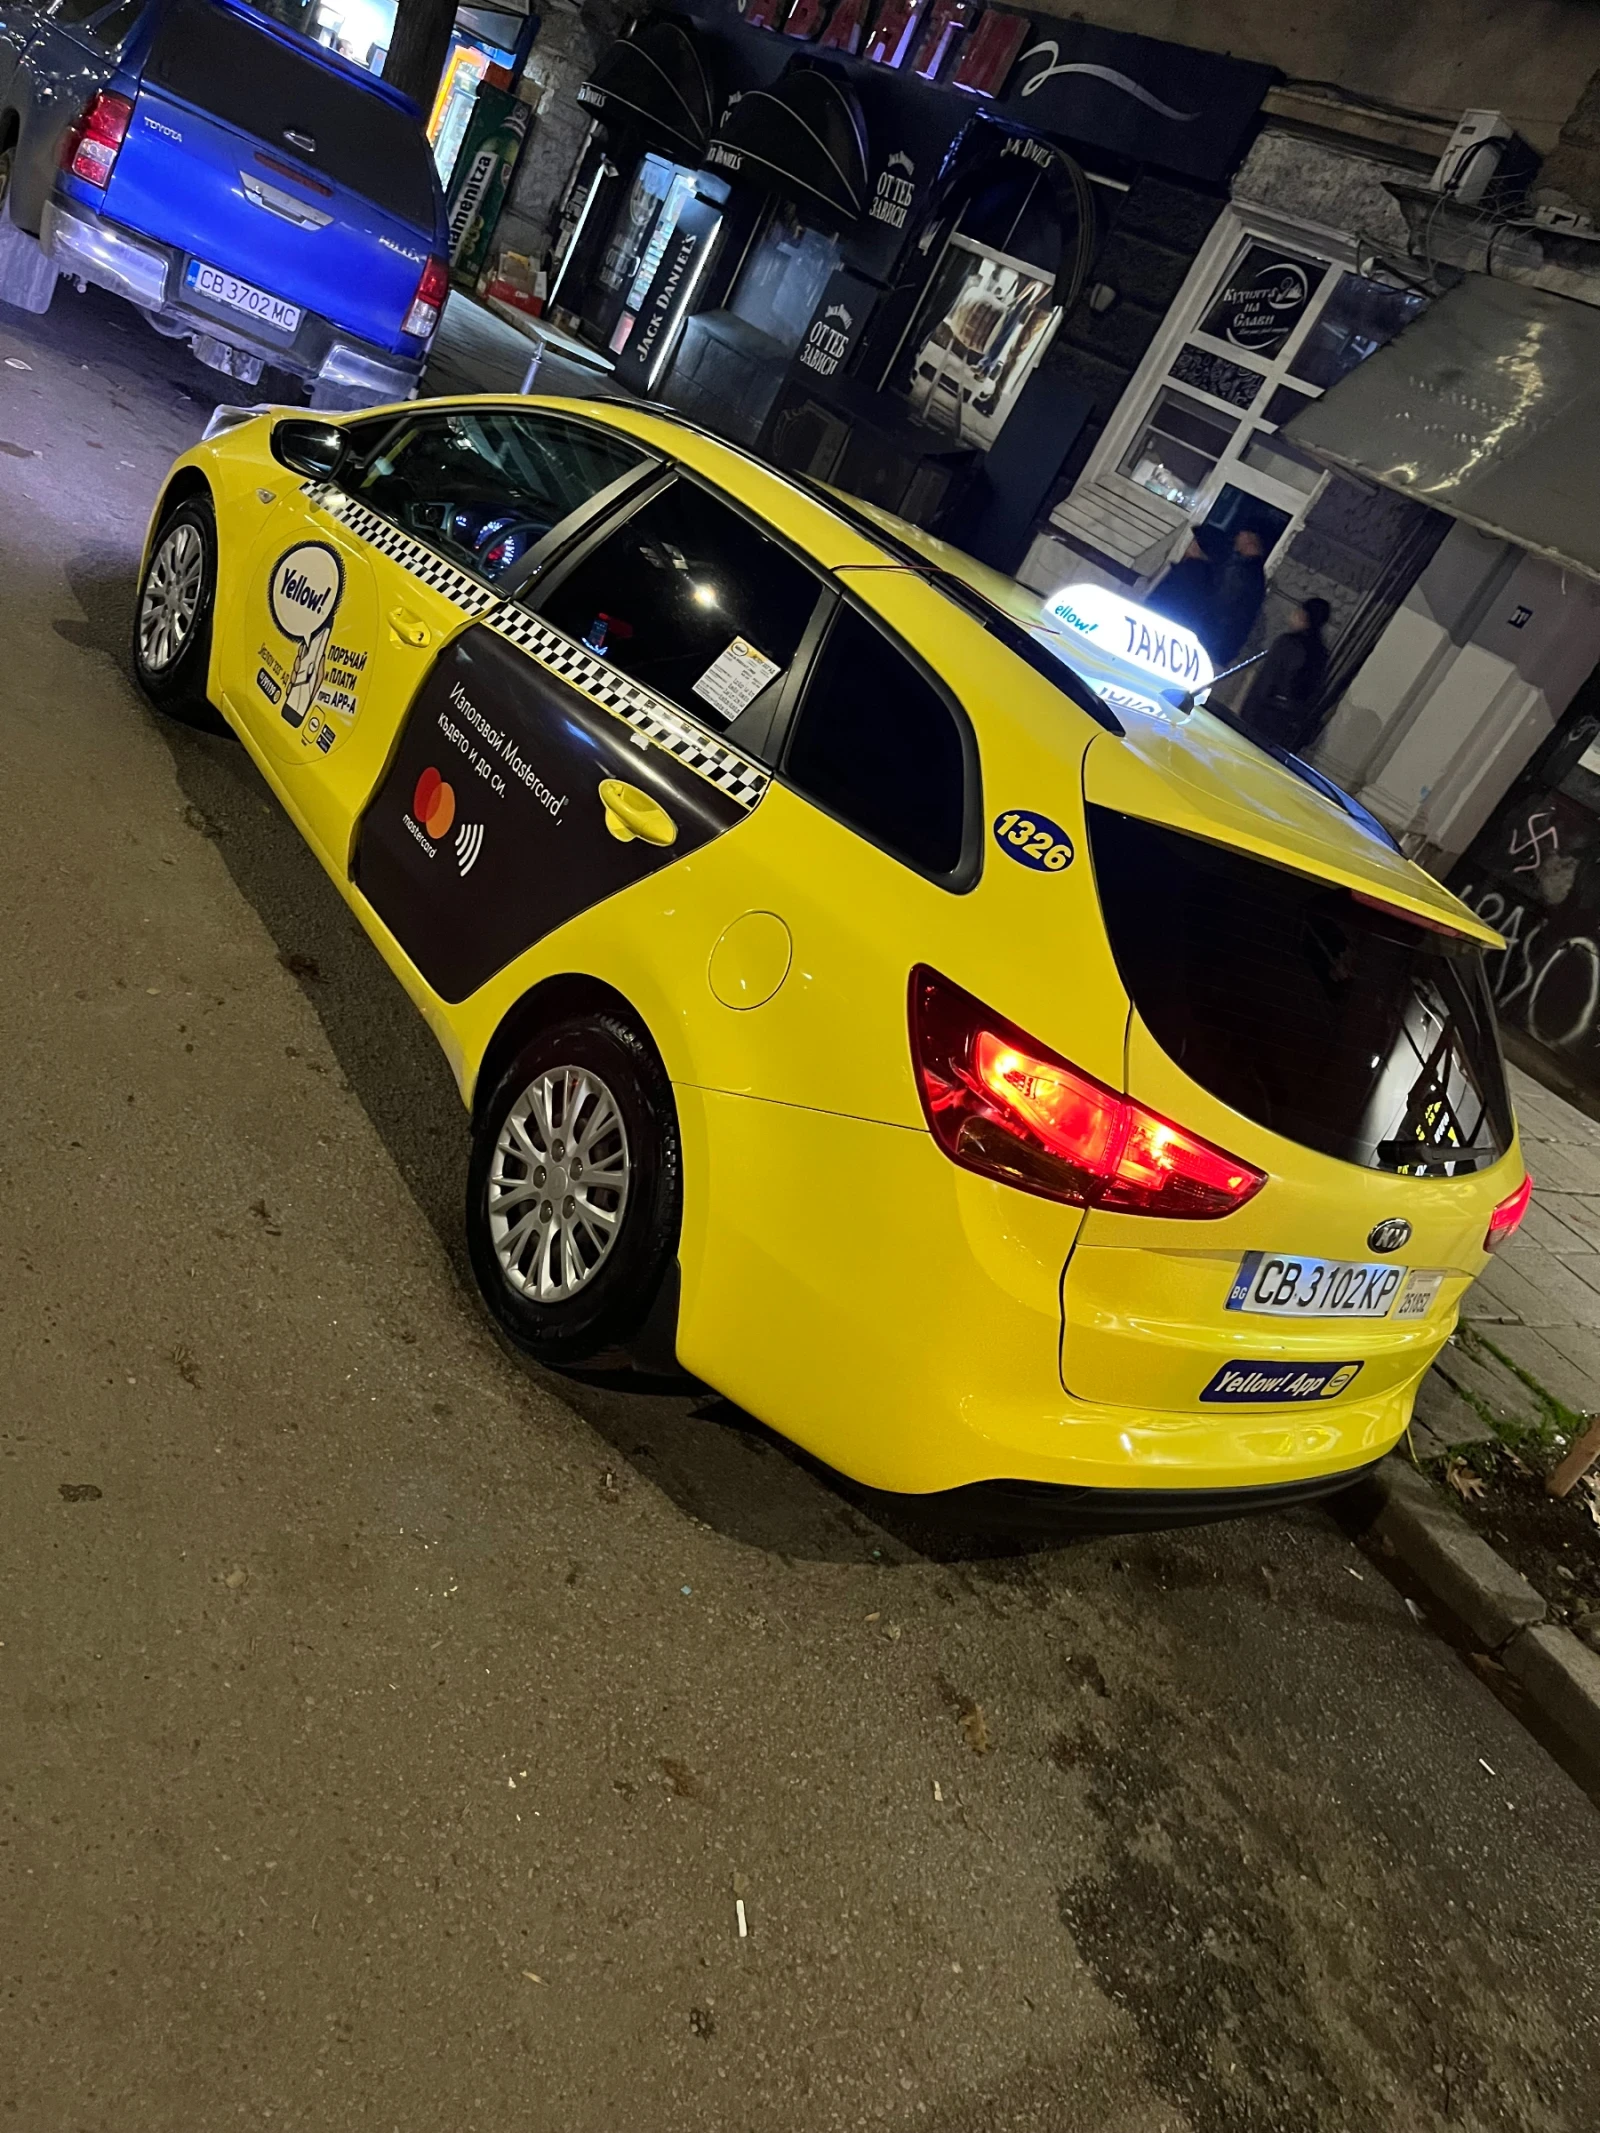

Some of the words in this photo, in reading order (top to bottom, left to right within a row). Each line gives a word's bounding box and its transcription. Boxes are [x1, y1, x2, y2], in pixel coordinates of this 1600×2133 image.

[144, 117, 182, 142] TOYOTA
[877, 171, 895, 198] ОТ
[892, 178, 915, 207] ТЕБ
[869, 196, 908, 229] ЗАВИСИ
[635, 314, 663, 363] JACK
[656, 233, 697, 310] DANIEL'S
[810, 321, 830, 347] ОТ
[824, 328, 850, 358] ТЕБ
[800, 343, 839, 376] ЗАВИСИ
[280, 568, 332, 615] Yellow!
[327, 644, 368, 671] ПОРЪЧАЙ
[1124, 615, 1200, 682] ТАКСИ
[329, 667, 358, 691] ПЛАТИ
[449, 681, 506, 751] Използвай
[437, 712, 470, 754] където
[468, 748, 479, 764] и
[474, 757, 492, 779] да
[490, 774, 506, 799] си.
[402, 813, 437, 859] mastercard
[997, 814, 1072, 870] 1326
[1375, 1226, 1408, 1249] KIA
[1230, 1285, 1248, 1300] BG
[1214, 1371, 1294, 1393] Yellow!
[1283, 1372, 1326, 1397] App
